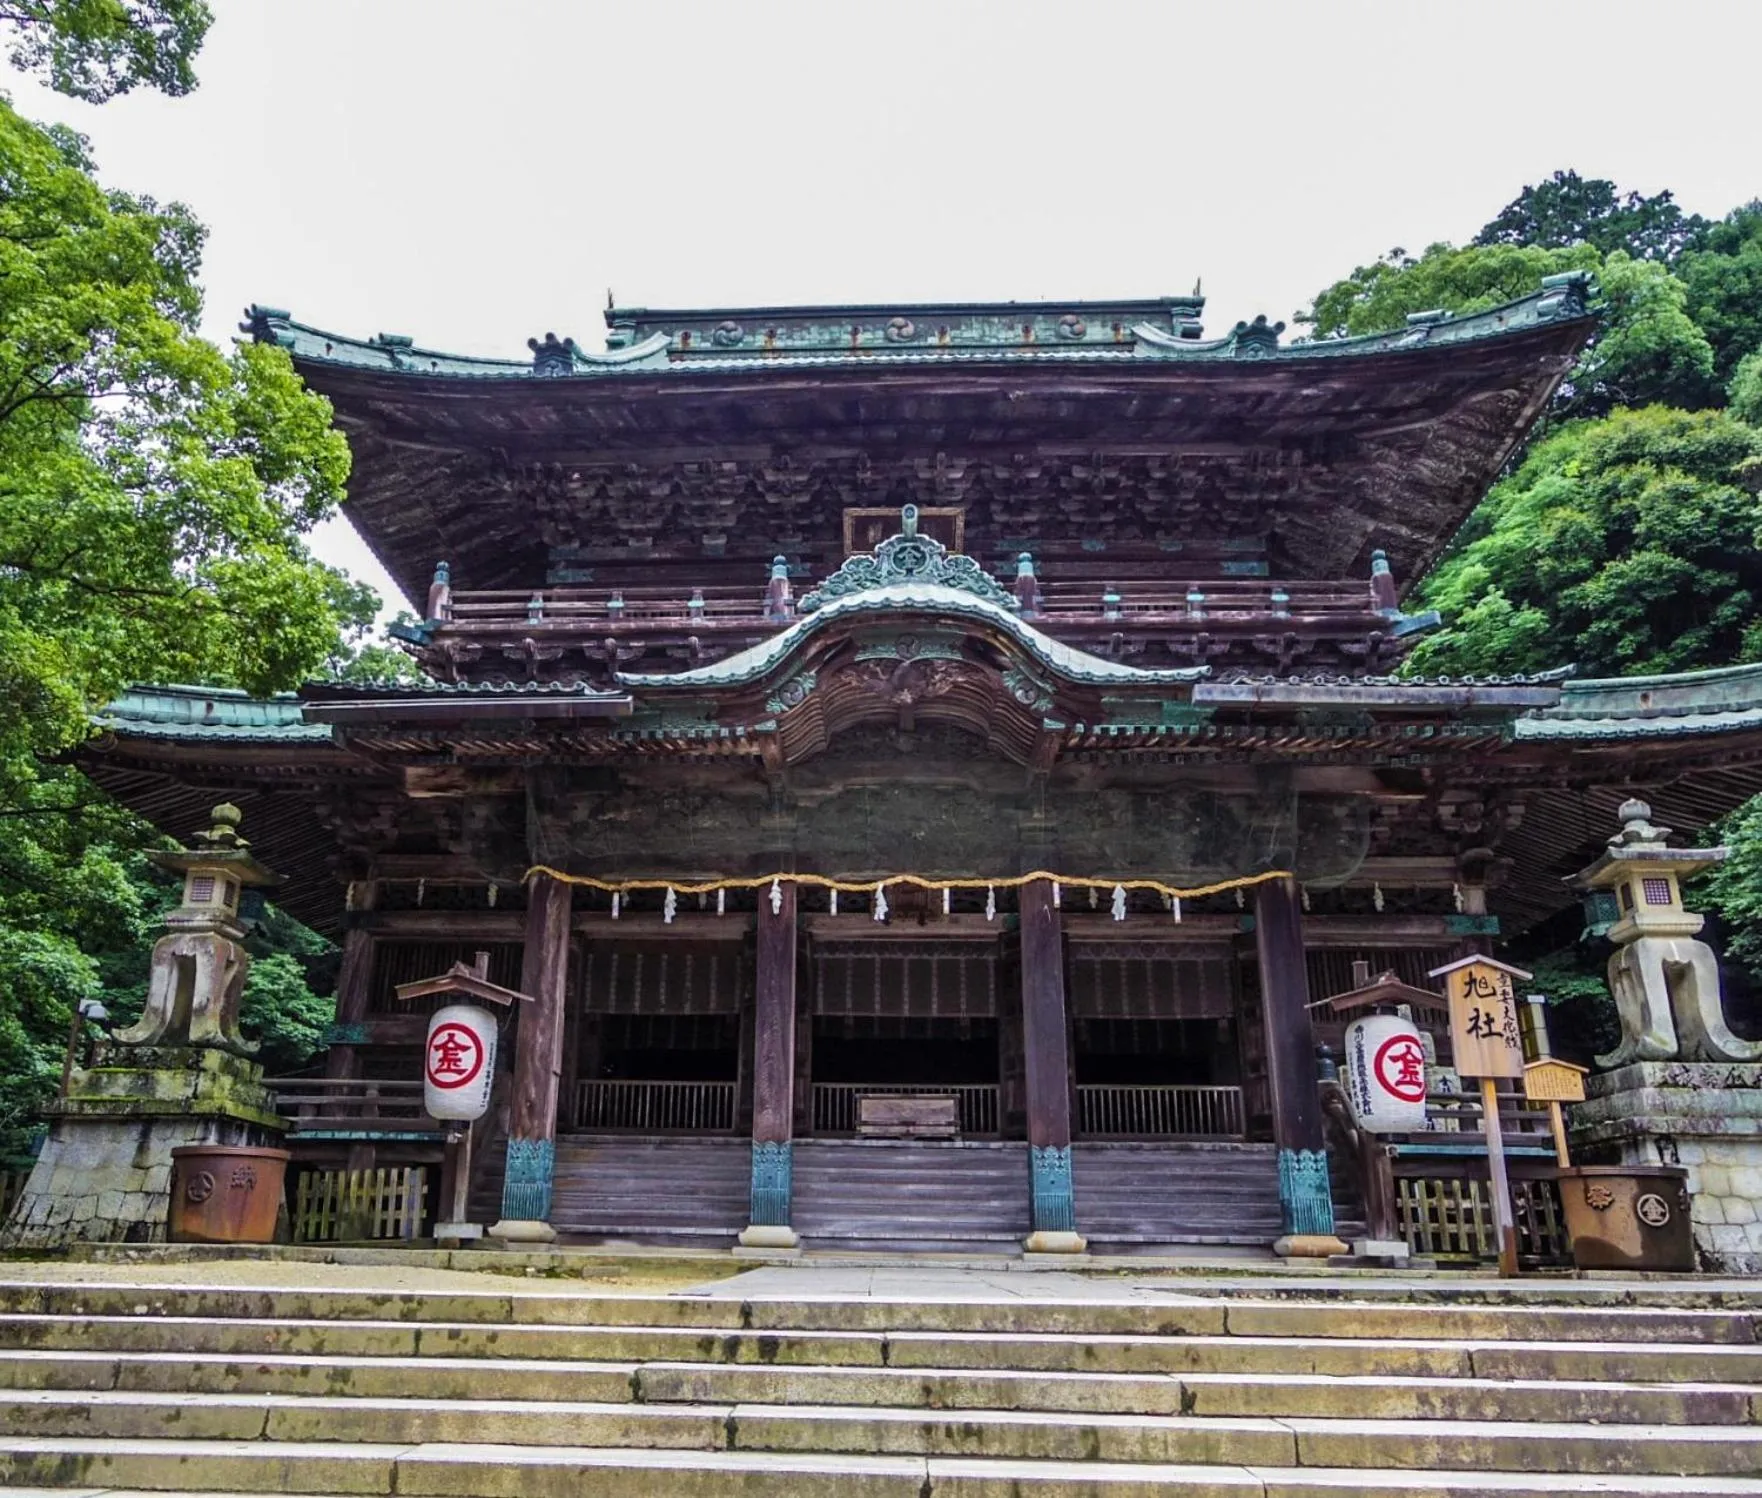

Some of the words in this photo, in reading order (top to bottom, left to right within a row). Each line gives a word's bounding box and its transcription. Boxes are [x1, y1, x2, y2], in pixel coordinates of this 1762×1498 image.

[1463, 970, 1504, 1039] 旭社
[433, 1032, 472, 1076] 金
[1387, 1044, 1425, 1089] 金
